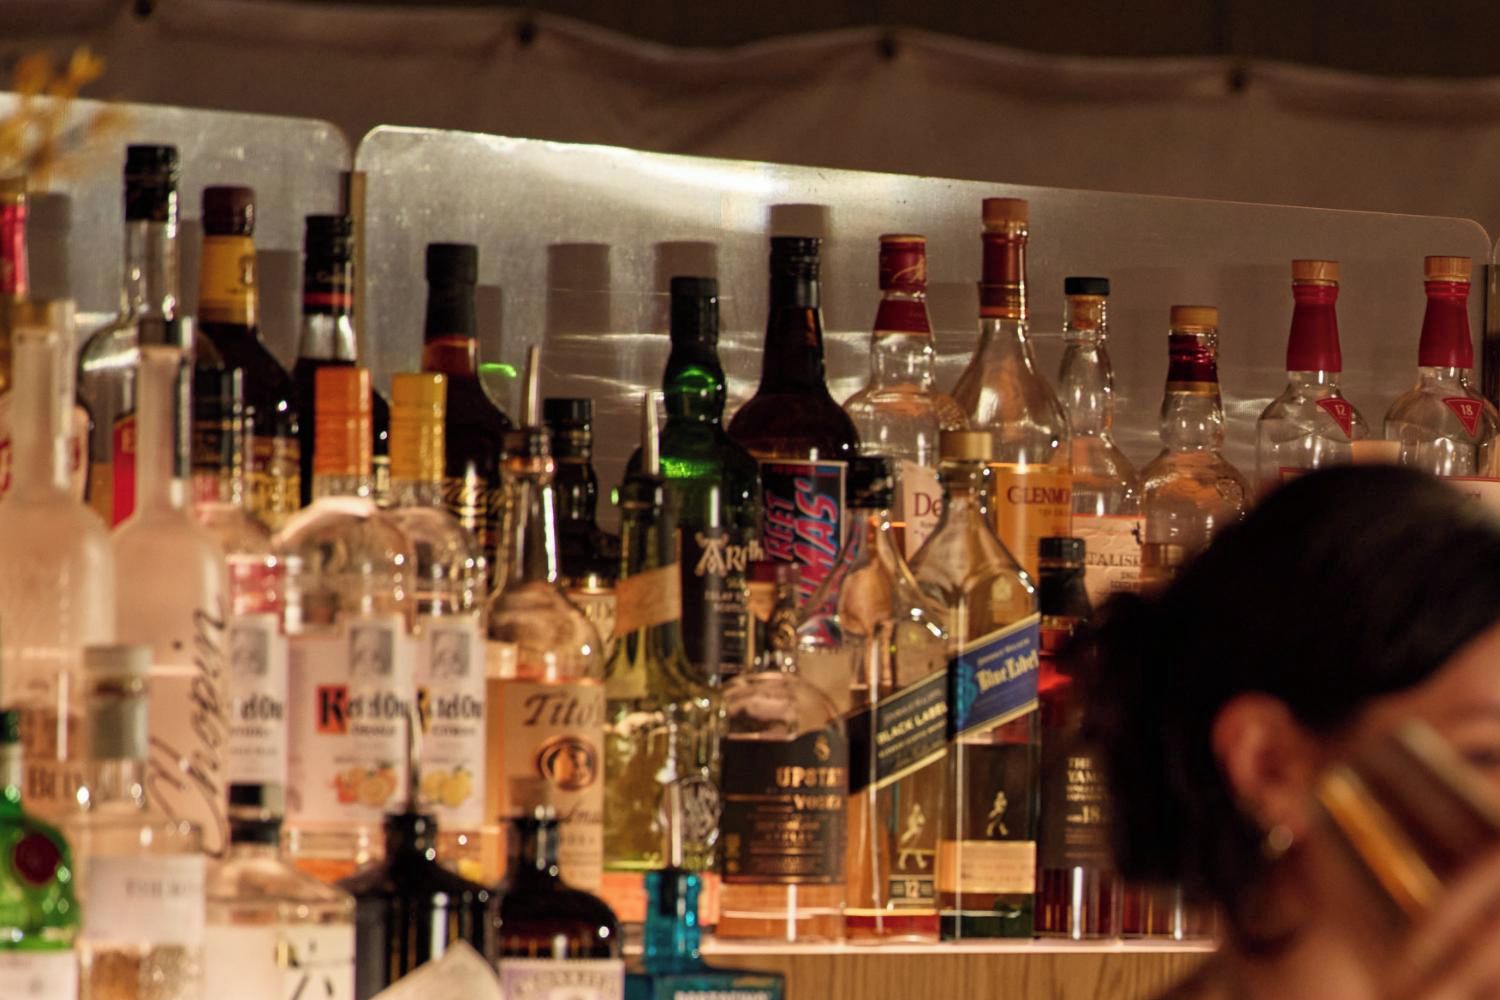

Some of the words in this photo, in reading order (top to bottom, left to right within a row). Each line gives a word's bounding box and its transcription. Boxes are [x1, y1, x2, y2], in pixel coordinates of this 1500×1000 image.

[1334, 404, 1346, 418] 12
[1459, 403, 1473, 416] 18
[877, 718, 914, 745] BLACK
[914, 701, 947, 727] LABEL
